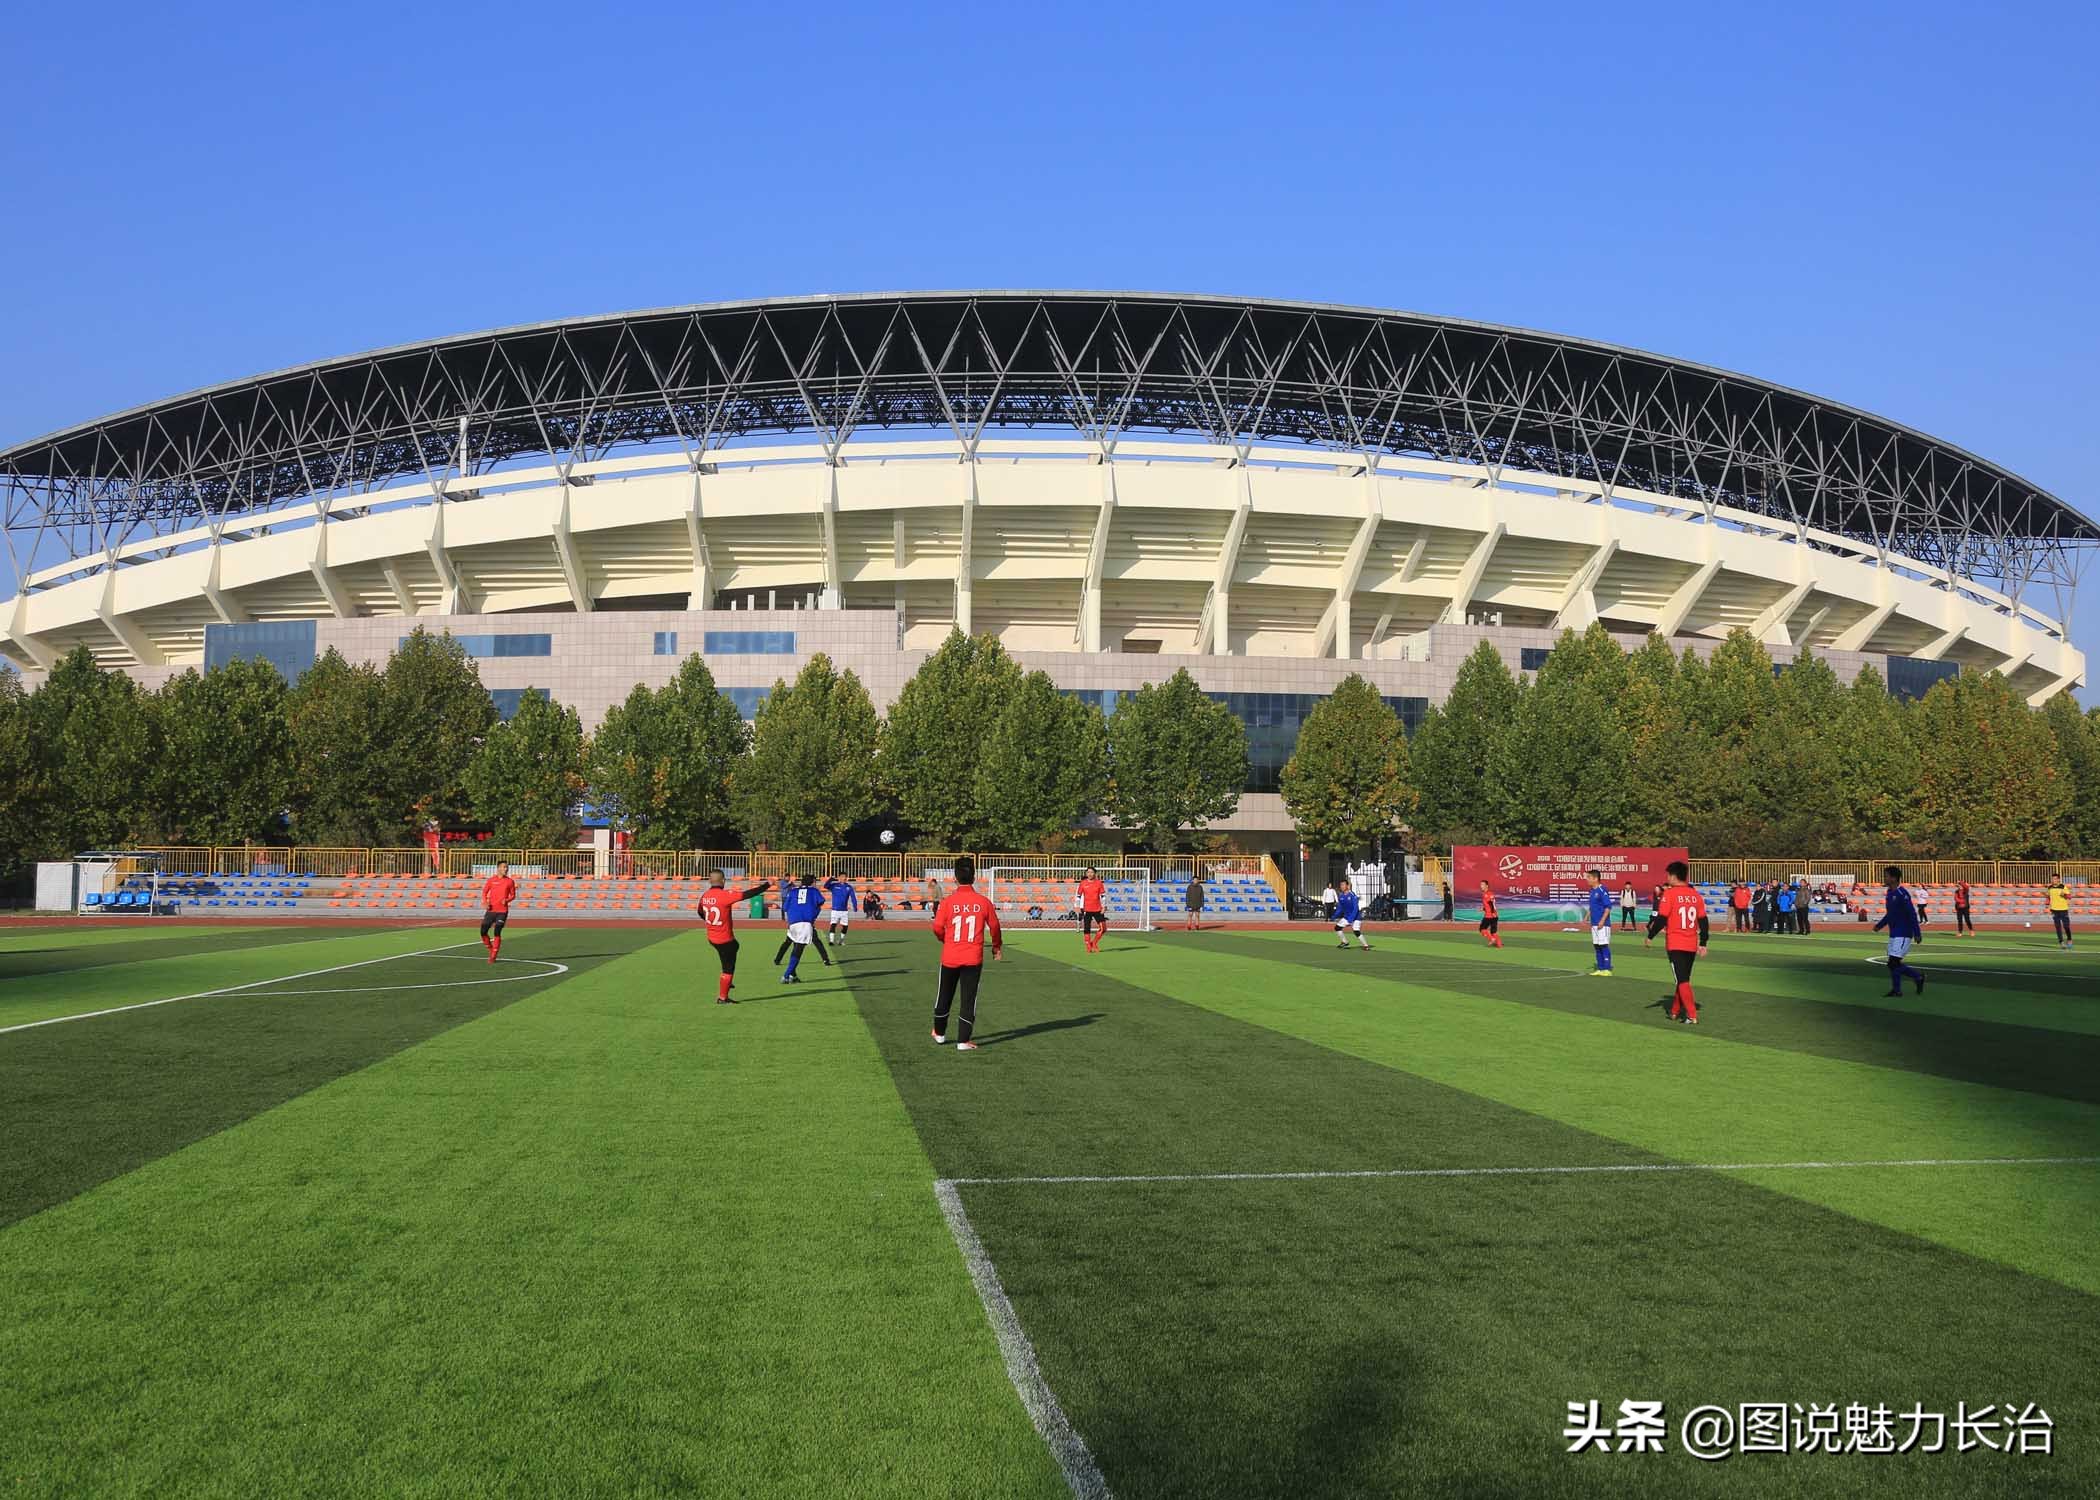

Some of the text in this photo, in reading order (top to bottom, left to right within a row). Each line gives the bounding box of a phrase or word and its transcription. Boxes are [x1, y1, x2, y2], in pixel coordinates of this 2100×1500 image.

[702, 897, 717, 905] BKD
[1677, 895, 1698, 904] BKD
[953, 903, 981, 914] BKD
[1678, 906, 1697, 930] 19
[952, 915, 976, 943] 11
